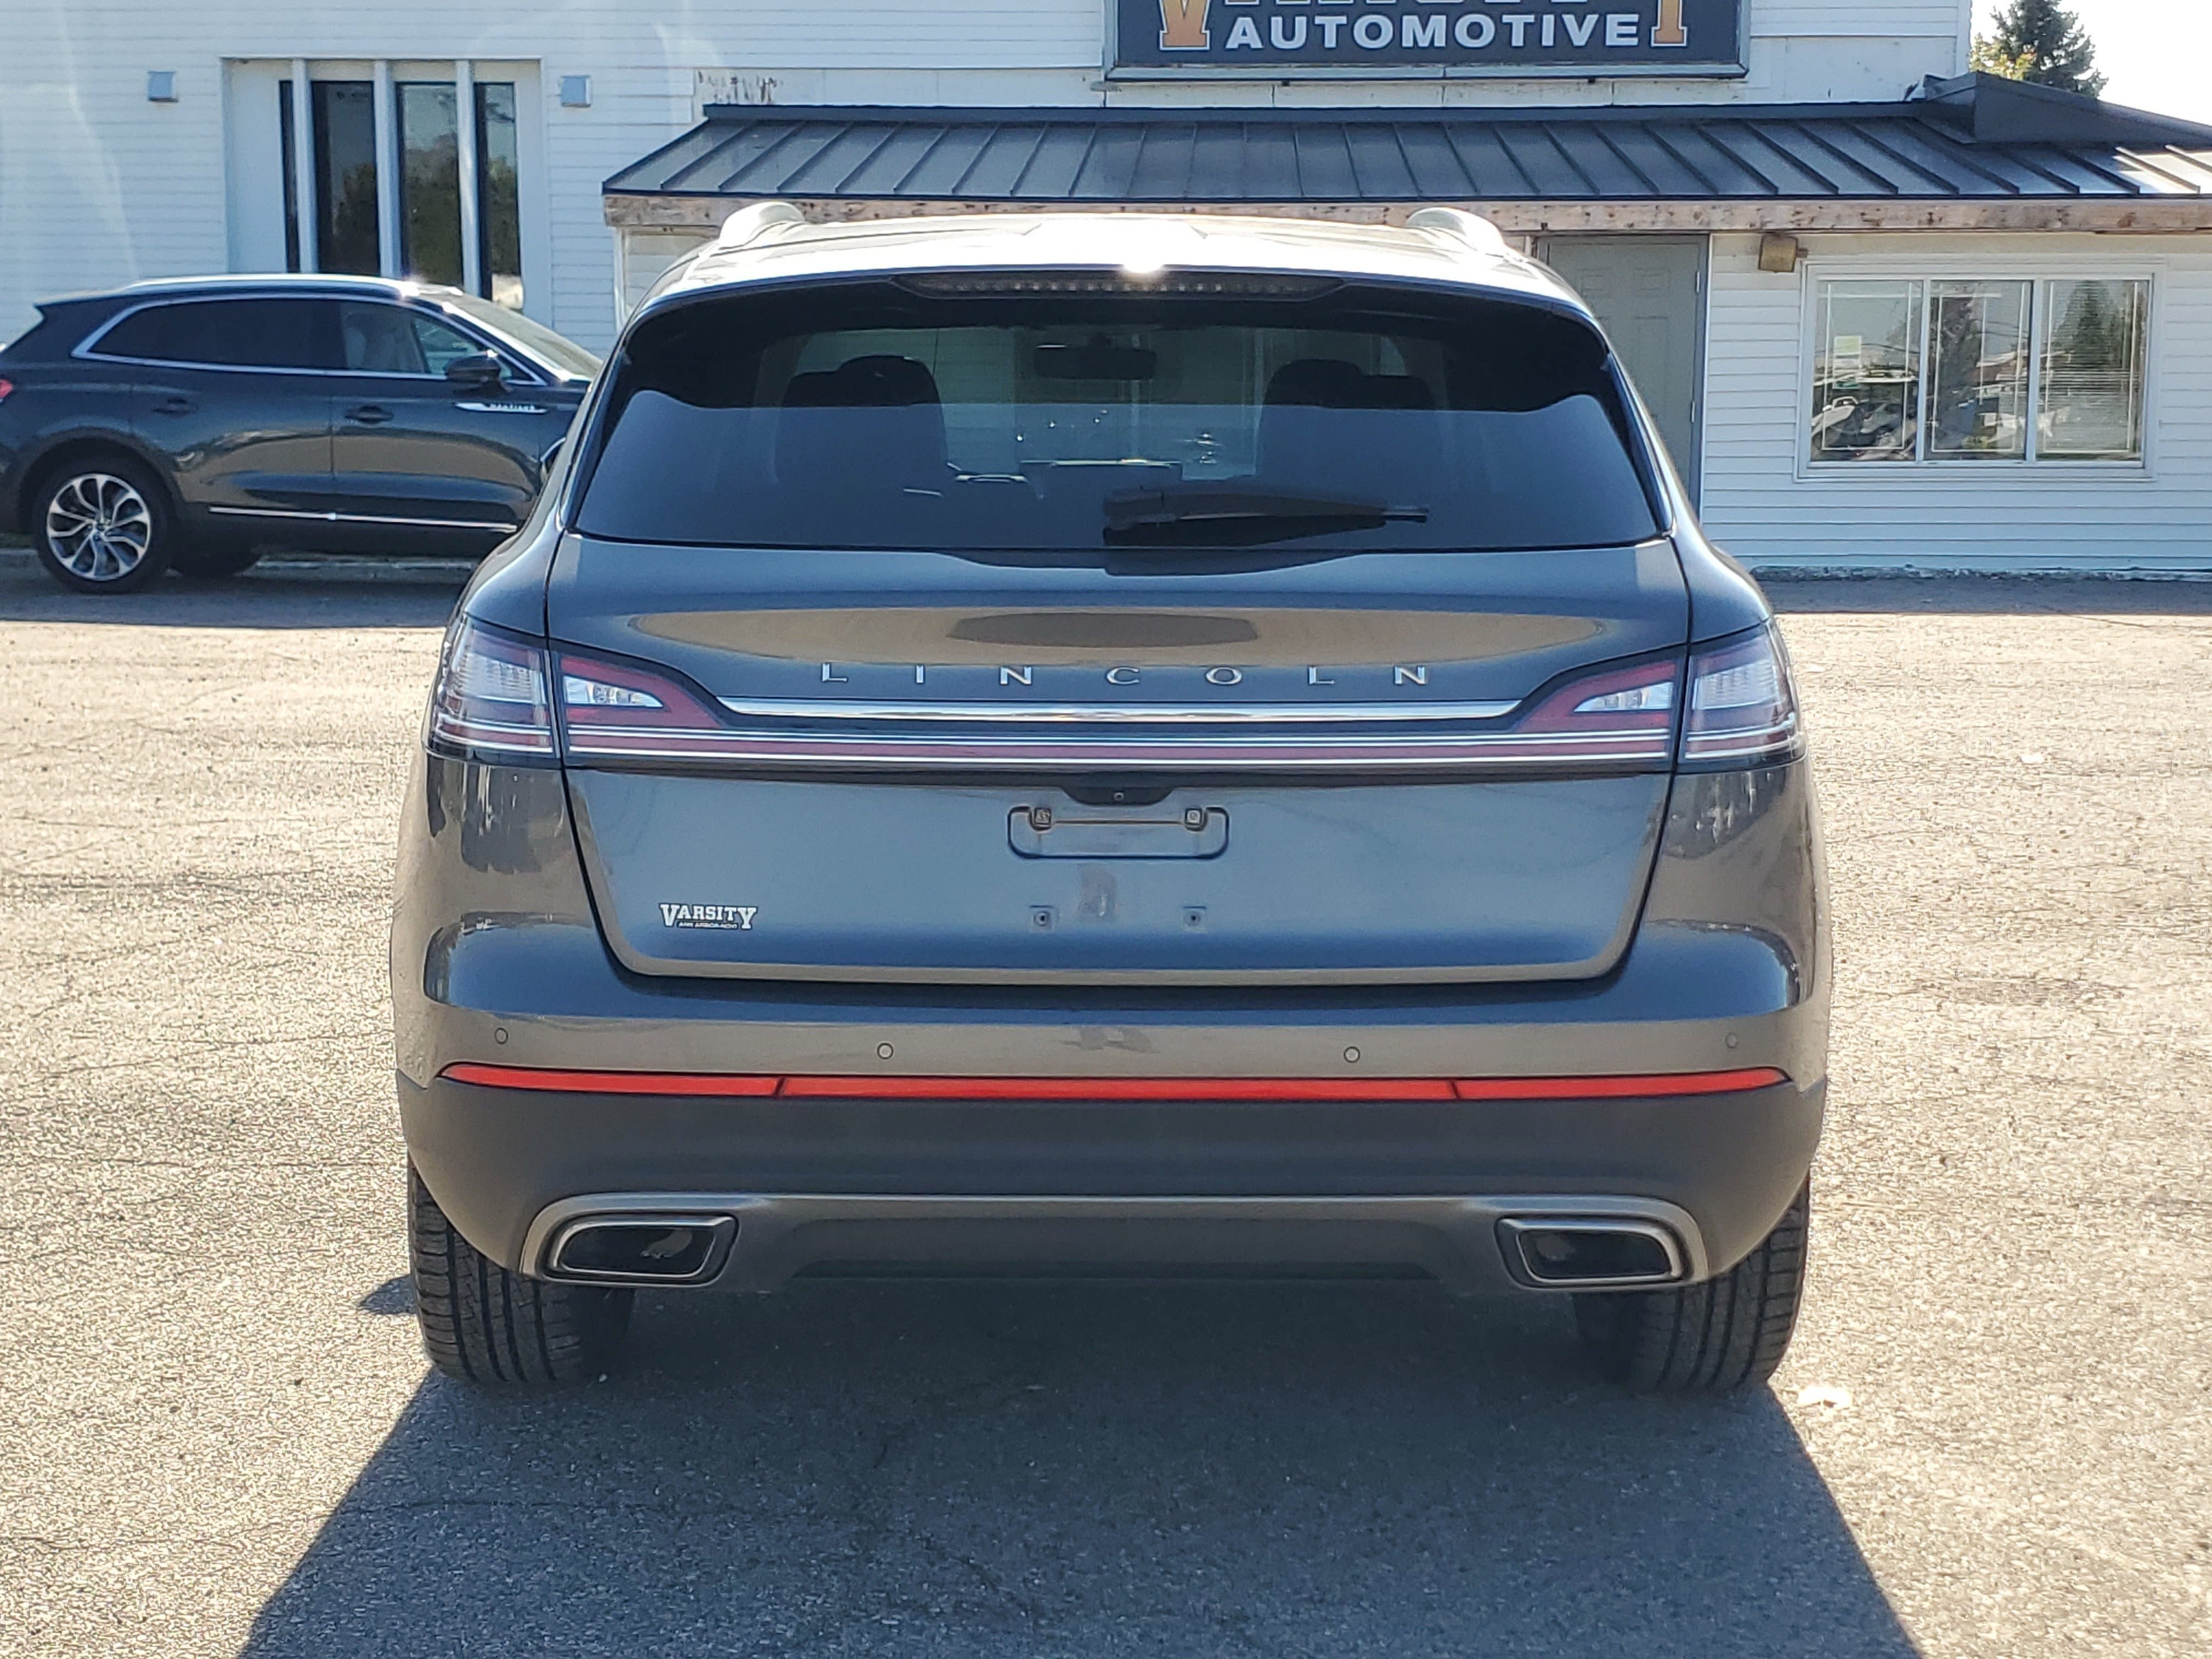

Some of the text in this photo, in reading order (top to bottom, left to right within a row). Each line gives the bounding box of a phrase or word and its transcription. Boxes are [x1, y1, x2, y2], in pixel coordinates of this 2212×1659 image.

[1225, 13, 1639, 49] AUTOMOTIVE
[822, 663, 1425, 686] LINCOLN
[660, 904, 757, 929] VARSITY
